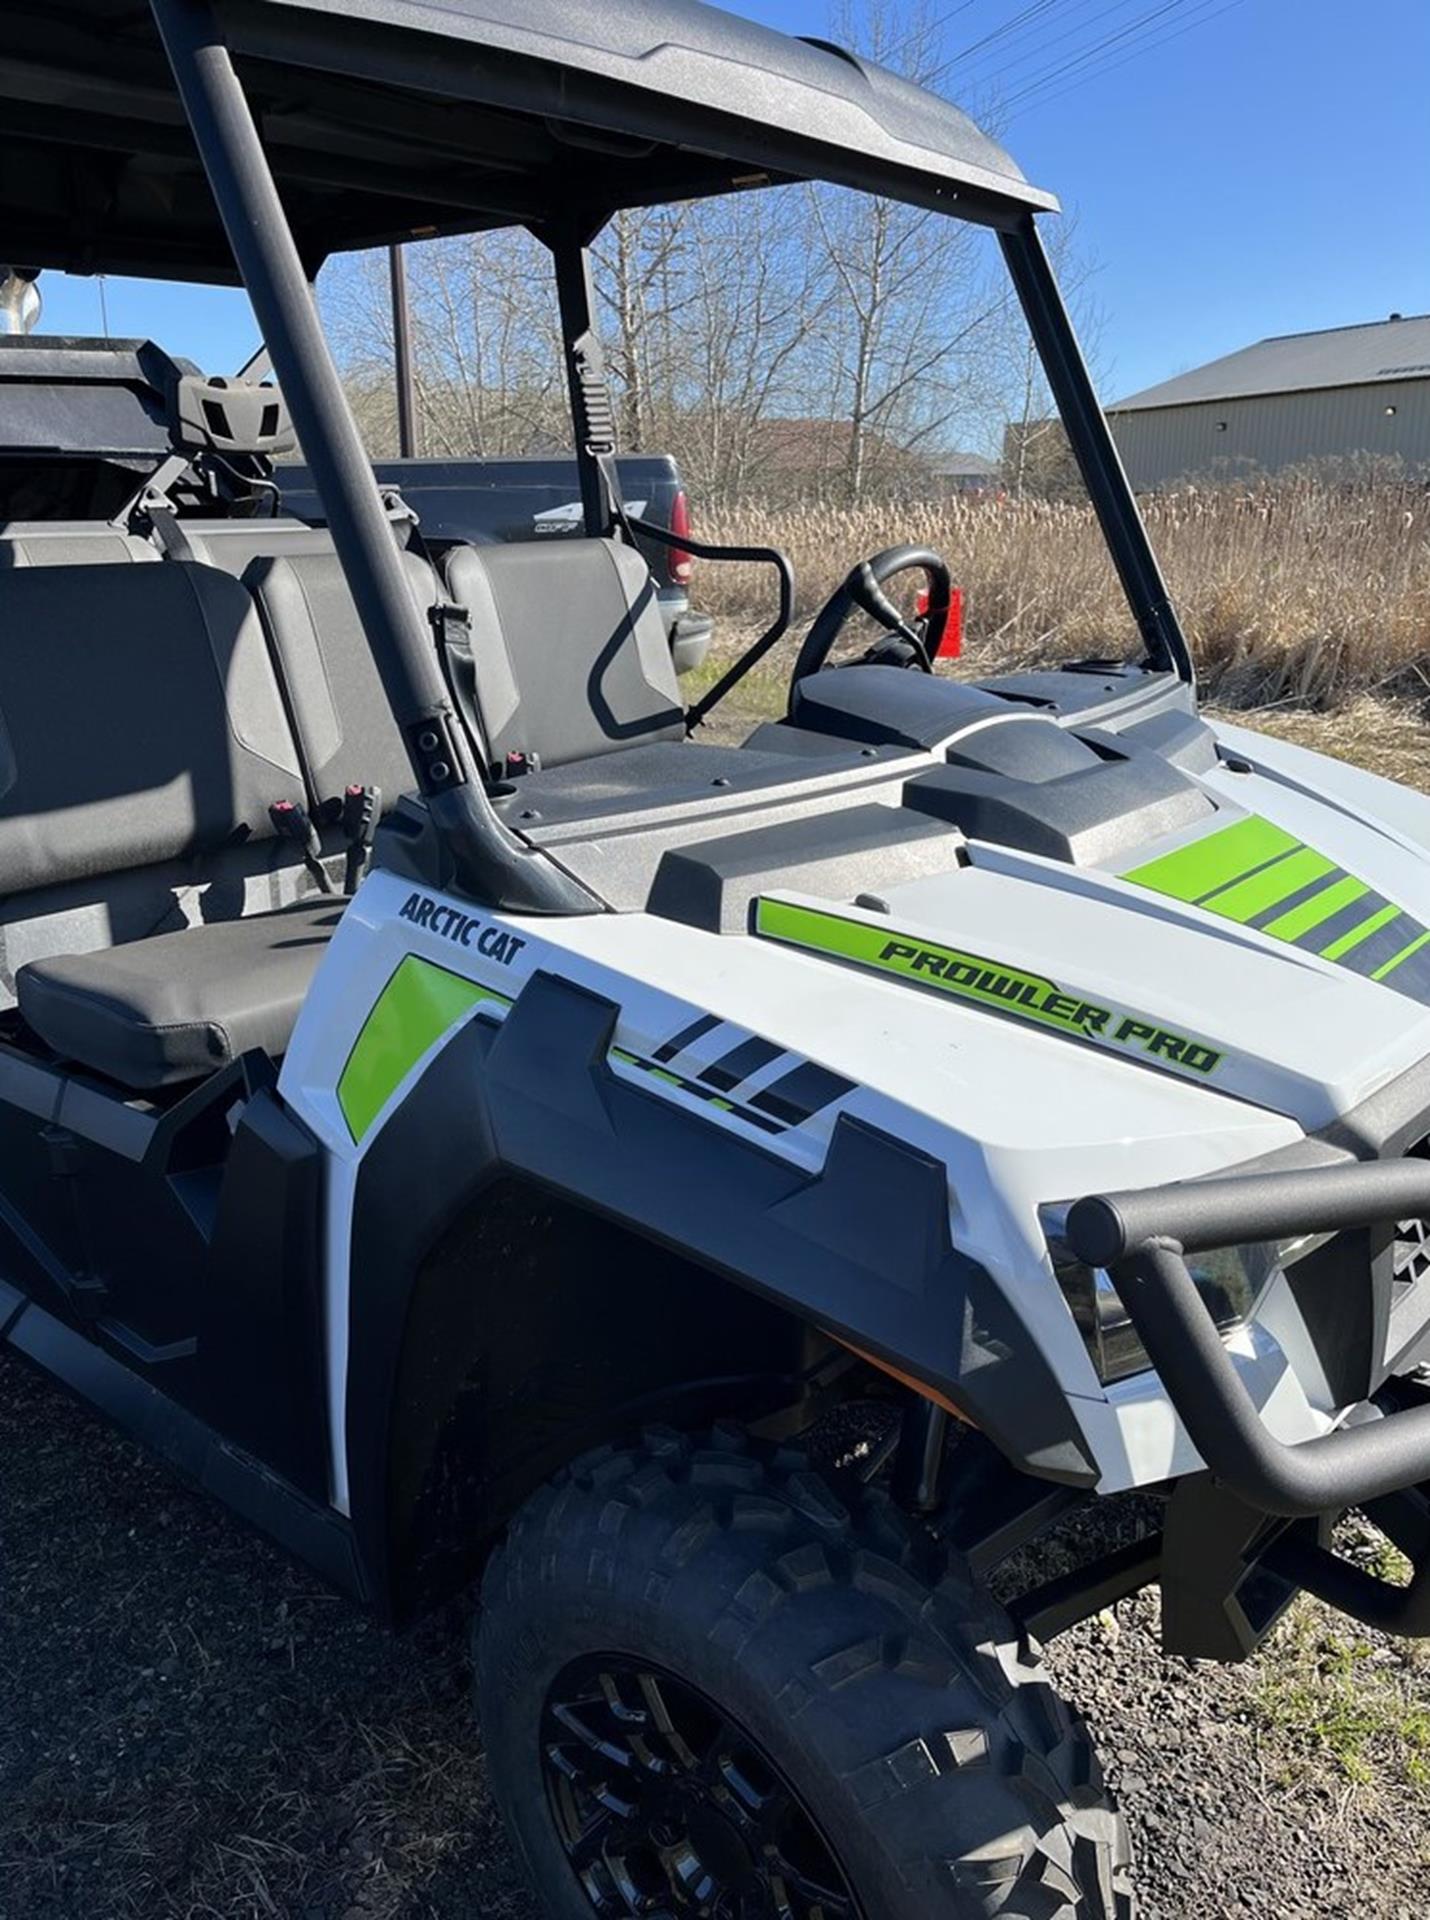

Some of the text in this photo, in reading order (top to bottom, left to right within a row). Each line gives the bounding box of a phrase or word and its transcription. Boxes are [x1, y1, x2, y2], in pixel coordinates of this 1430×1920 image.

[399, 893, 526, 966] ARCTIC CAT
[879, 941, 1221, 1074] PROWLER PRO
